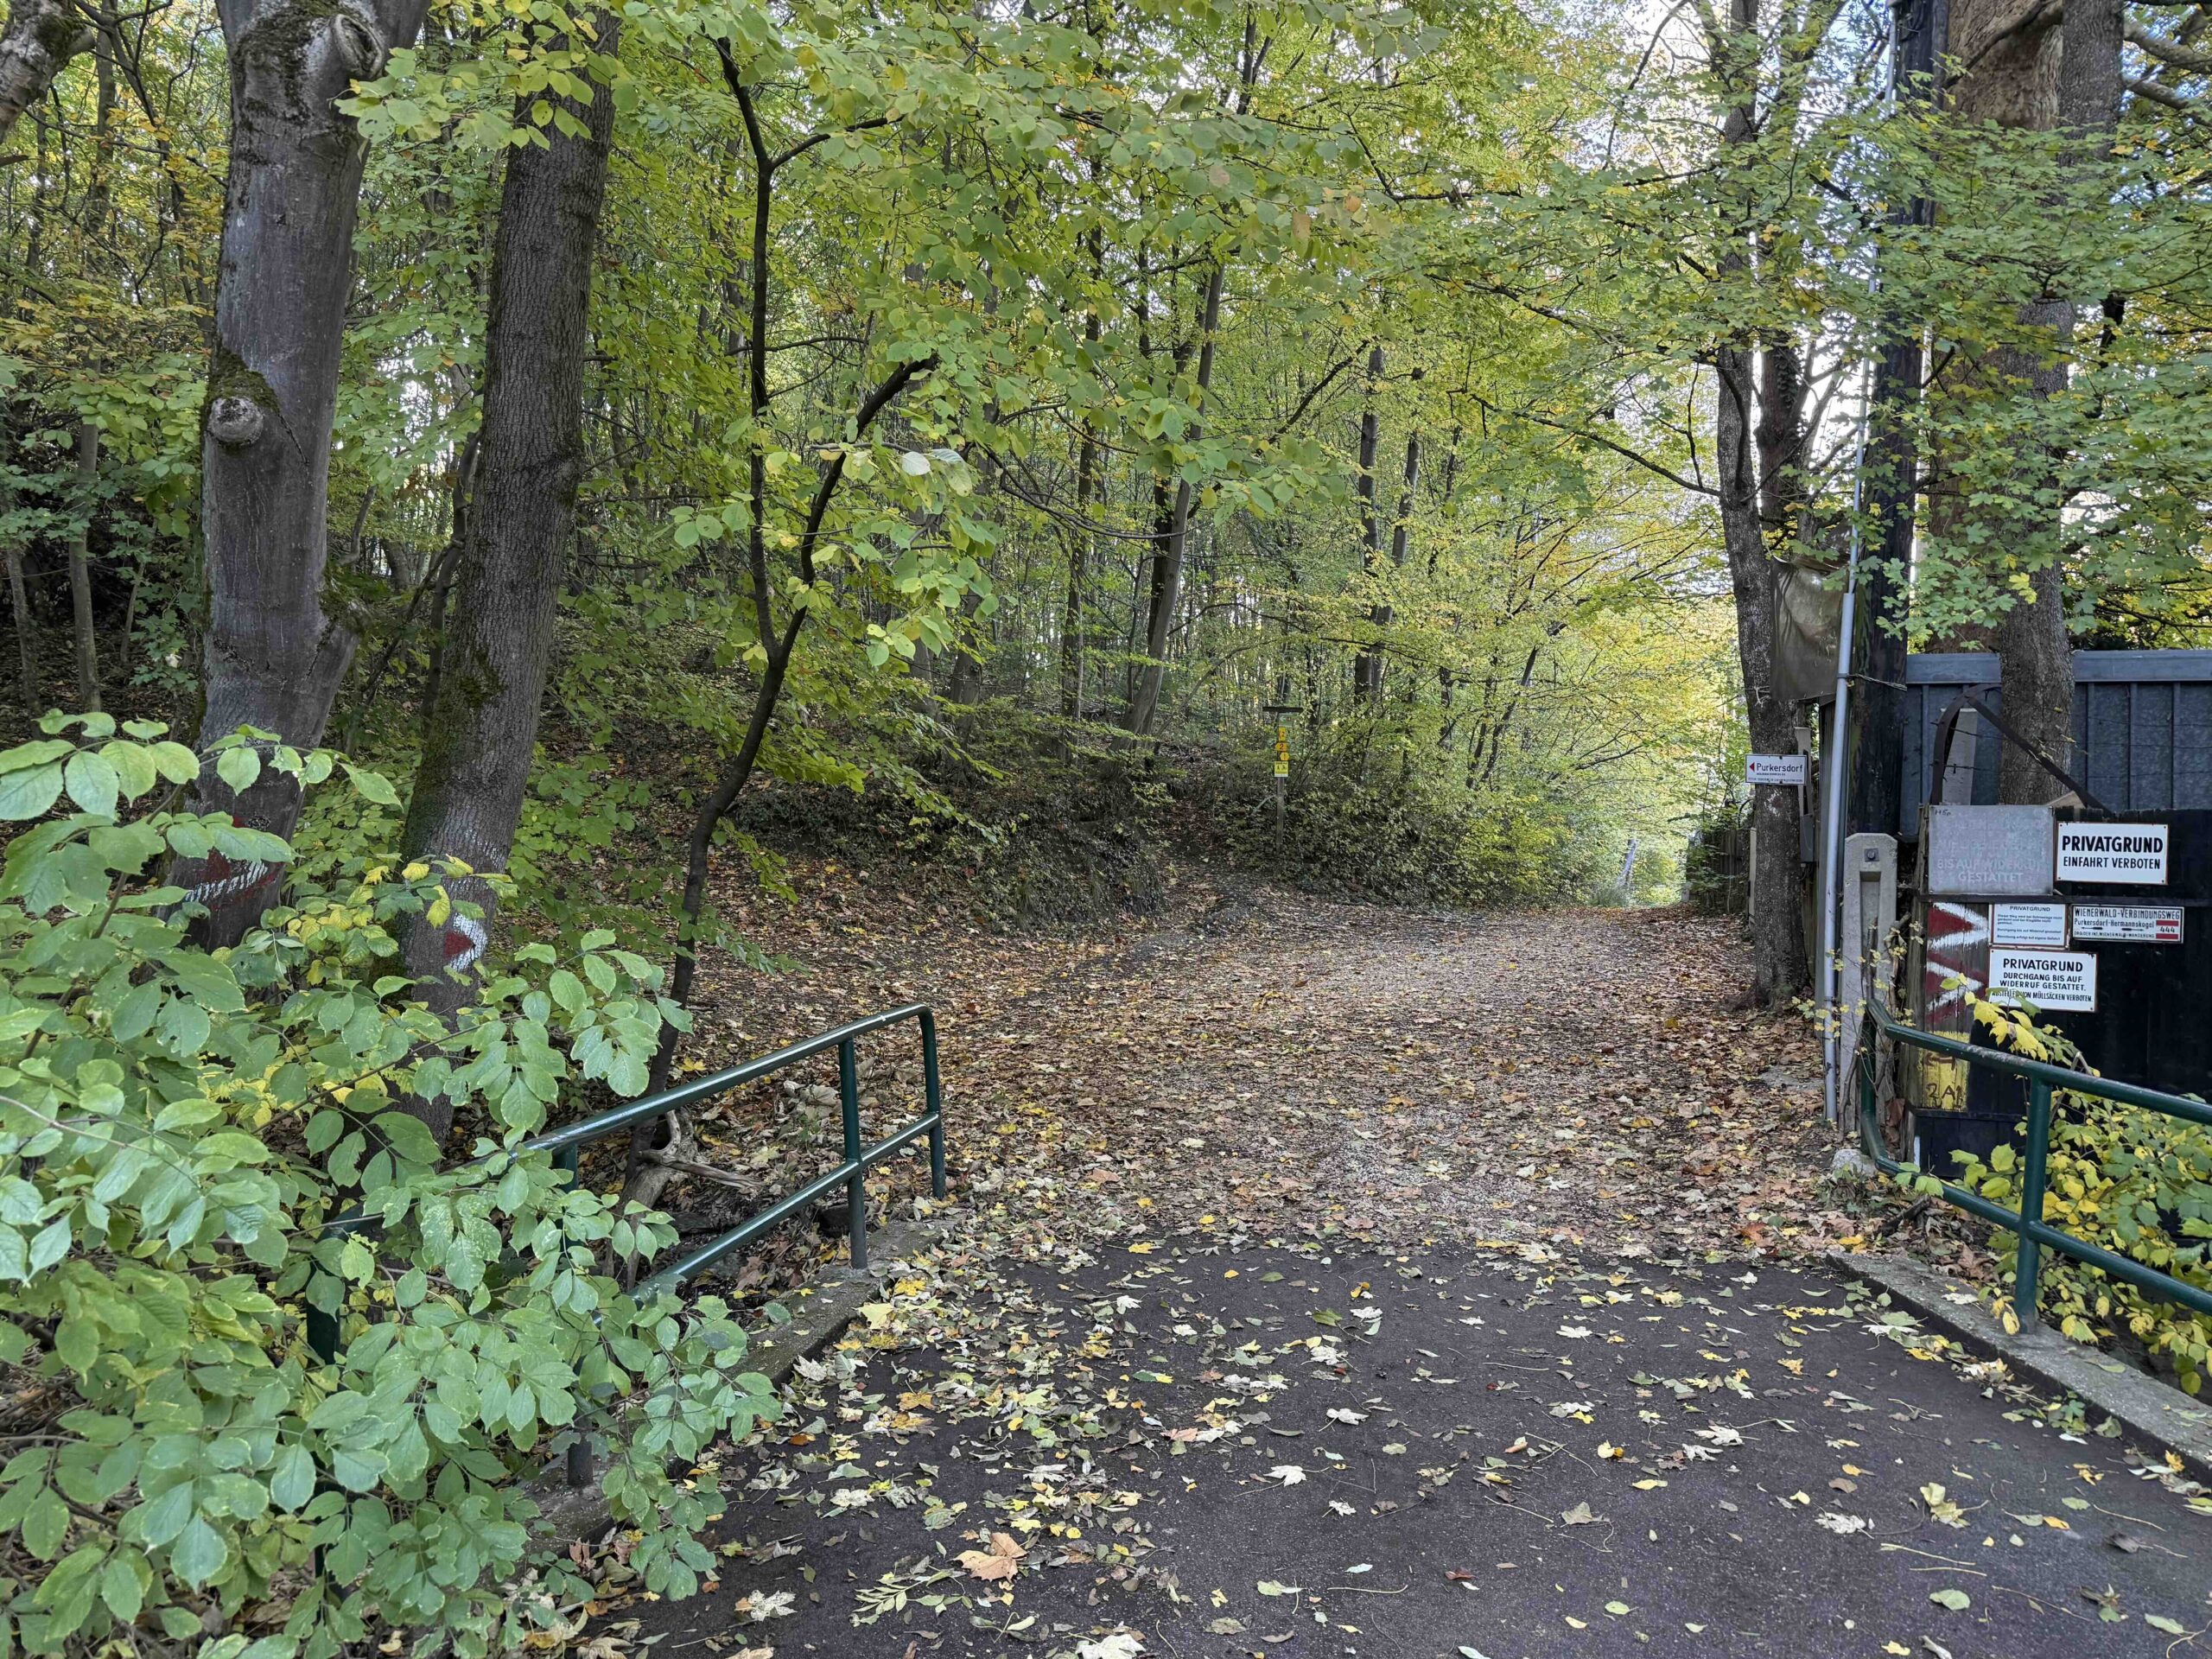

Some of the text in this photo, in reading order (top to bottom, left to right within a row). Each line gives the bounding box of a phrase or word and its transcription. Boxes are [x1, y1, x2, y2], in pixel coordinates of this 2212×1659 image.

[1757, 762, 1803, 772] Purkersdorf
[2062, 836, 2164, 853] PRIVATGRUND
[1937, 858, 1954, 869] BIS
[1956, 858, 1977, 870] AUF
[2063, 856, 2161, 869] EINFAHRT VERBOTEN
[1958, 871, 2024, 882] GESTATTET
[2074, 906, 2180, 919] WIENERWALD-VERBINDUNGSWEG
[2003, 958, 2083, 972] PRIVATGRUND
[2003, 972, 2050, 981] DURCHGANG
[1999, 980, 2087, 991] WIDERRUF GESTATTET.
[2032, 991, 2066, 1001] MÜLLSÄCKEN
